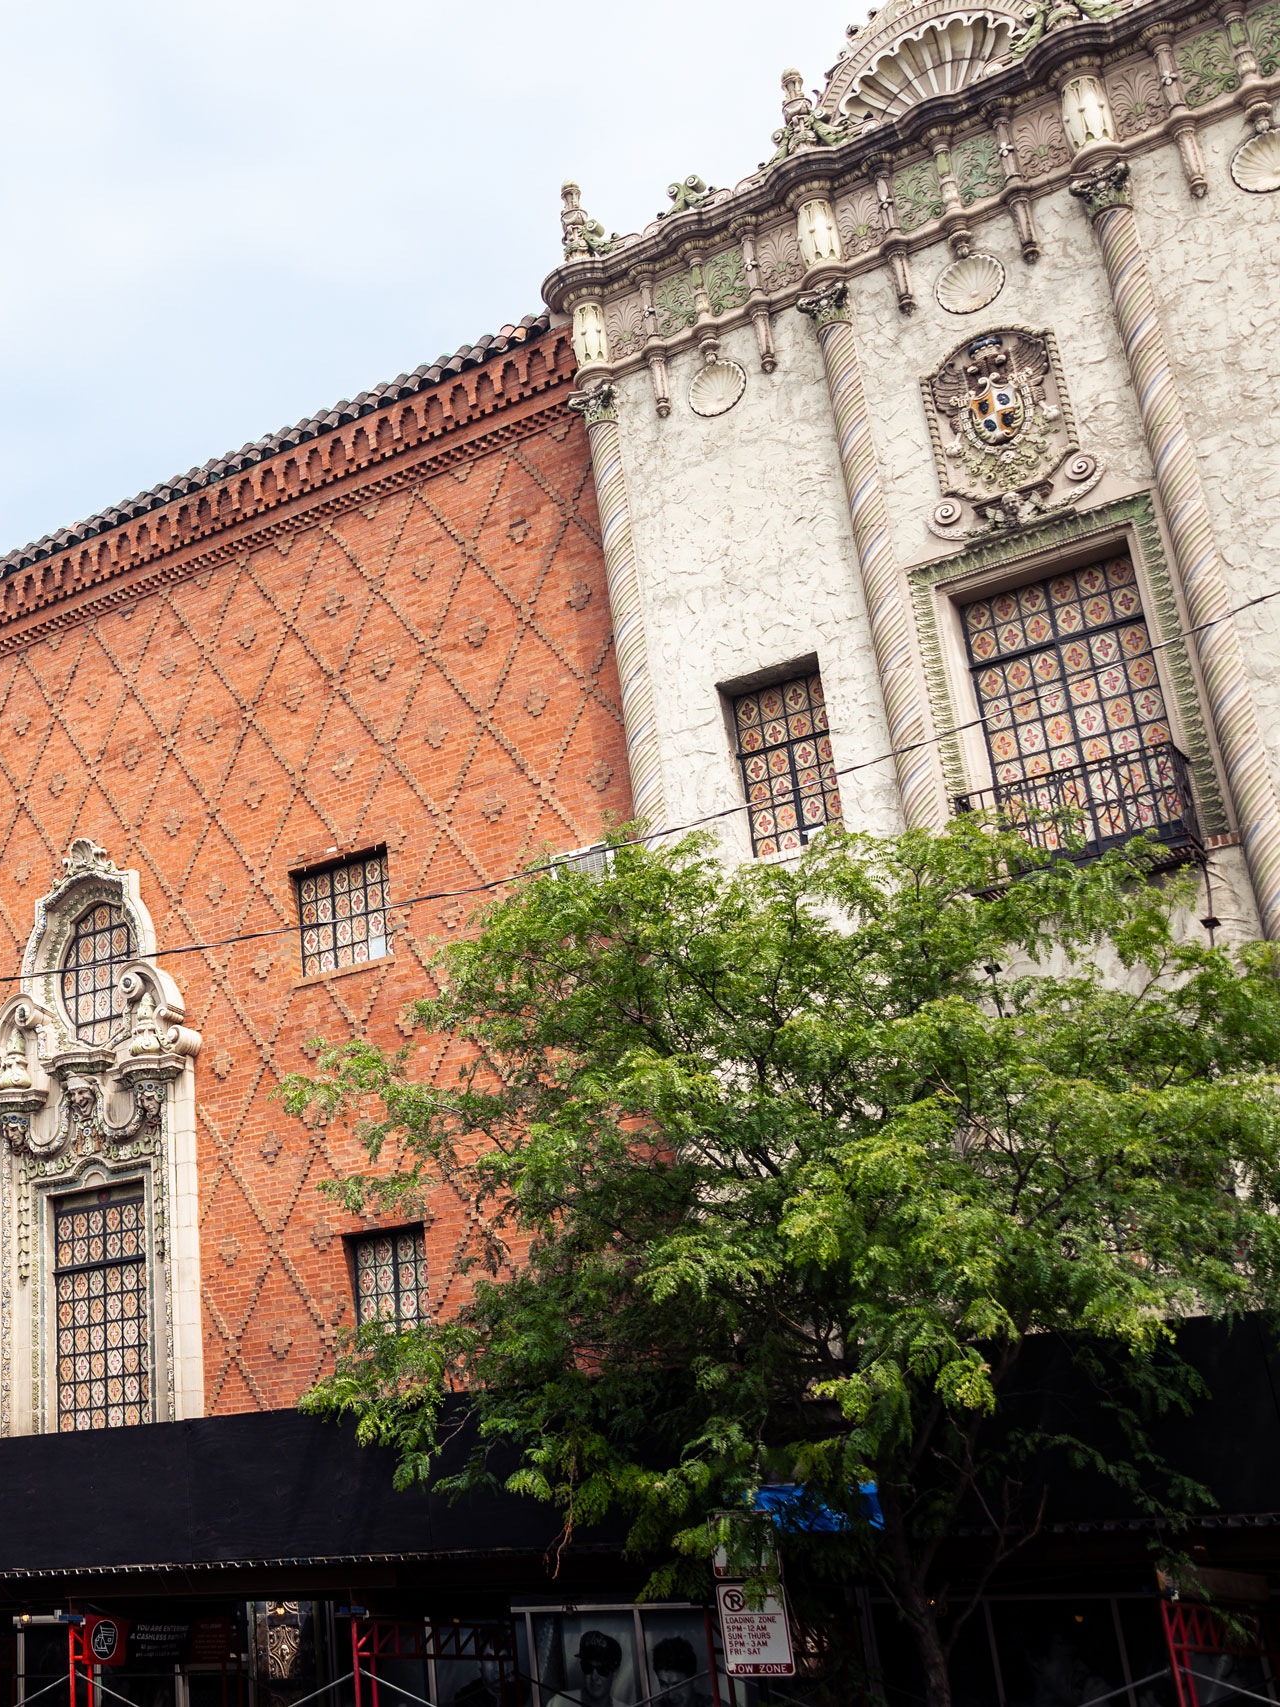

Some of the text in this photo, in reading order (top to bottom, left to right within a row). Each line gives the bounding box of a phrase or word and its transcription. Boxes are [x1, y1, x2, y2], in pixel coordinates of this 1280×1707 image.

[725, 1616, 755, 1624] LOADING
[150, 1624, 163, 1632] ARE
[759, 1664, 787, 1673] ZONE
